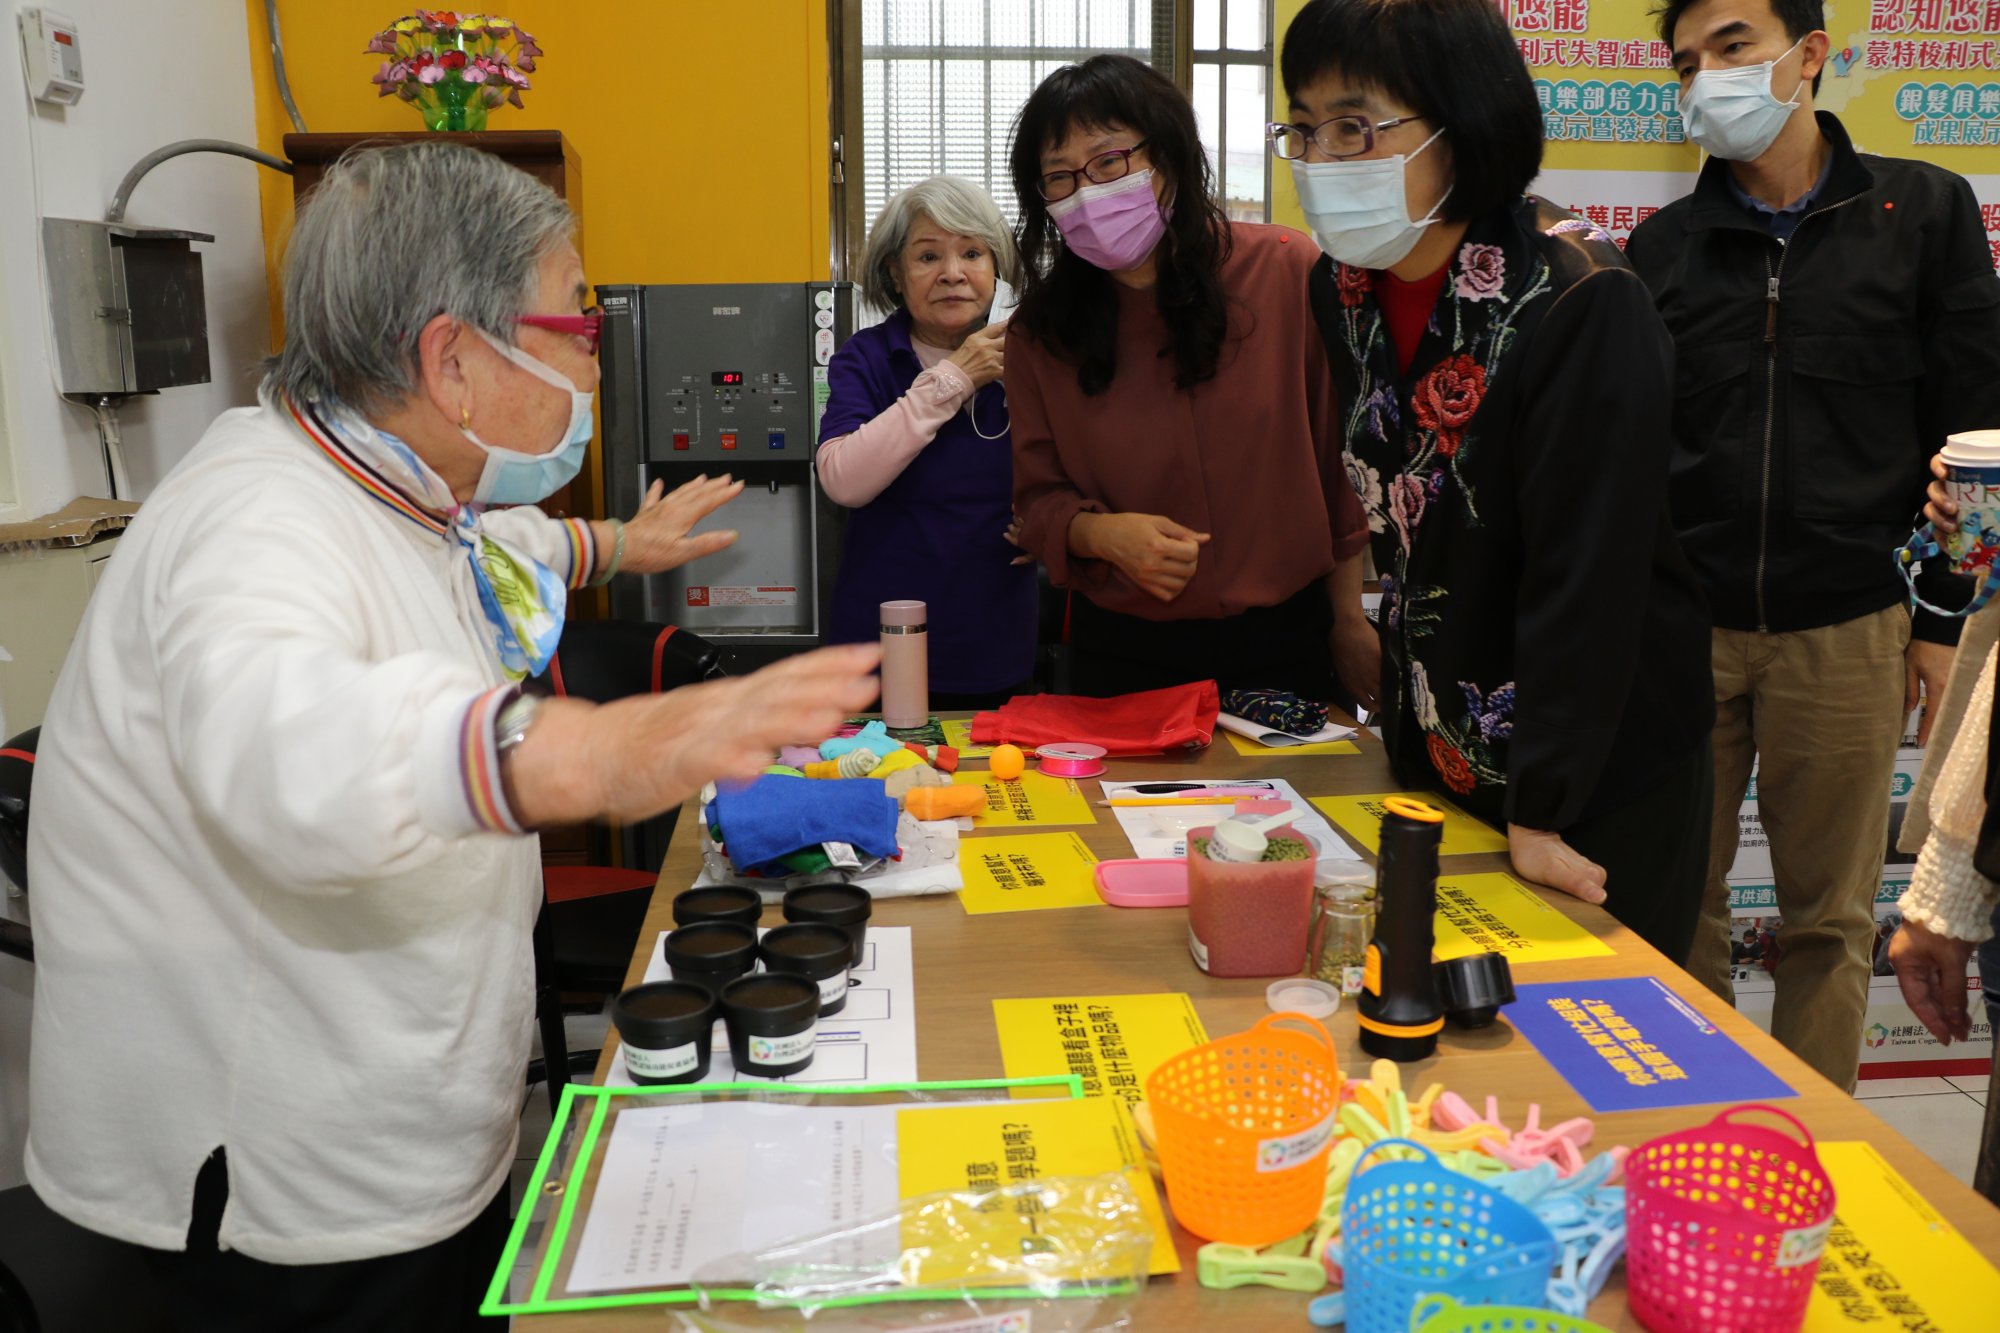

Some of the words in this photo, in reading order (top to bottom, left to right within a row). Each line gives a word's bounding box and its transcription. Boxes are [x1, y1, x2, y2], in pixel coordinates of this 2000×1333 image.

[1500, 0, 1588, 32] 悠能
[1866, 40, 2000, 69] 蒙特梭利式
[1087, 1005, 1142, 1112] 的是什麼物品嗎?
